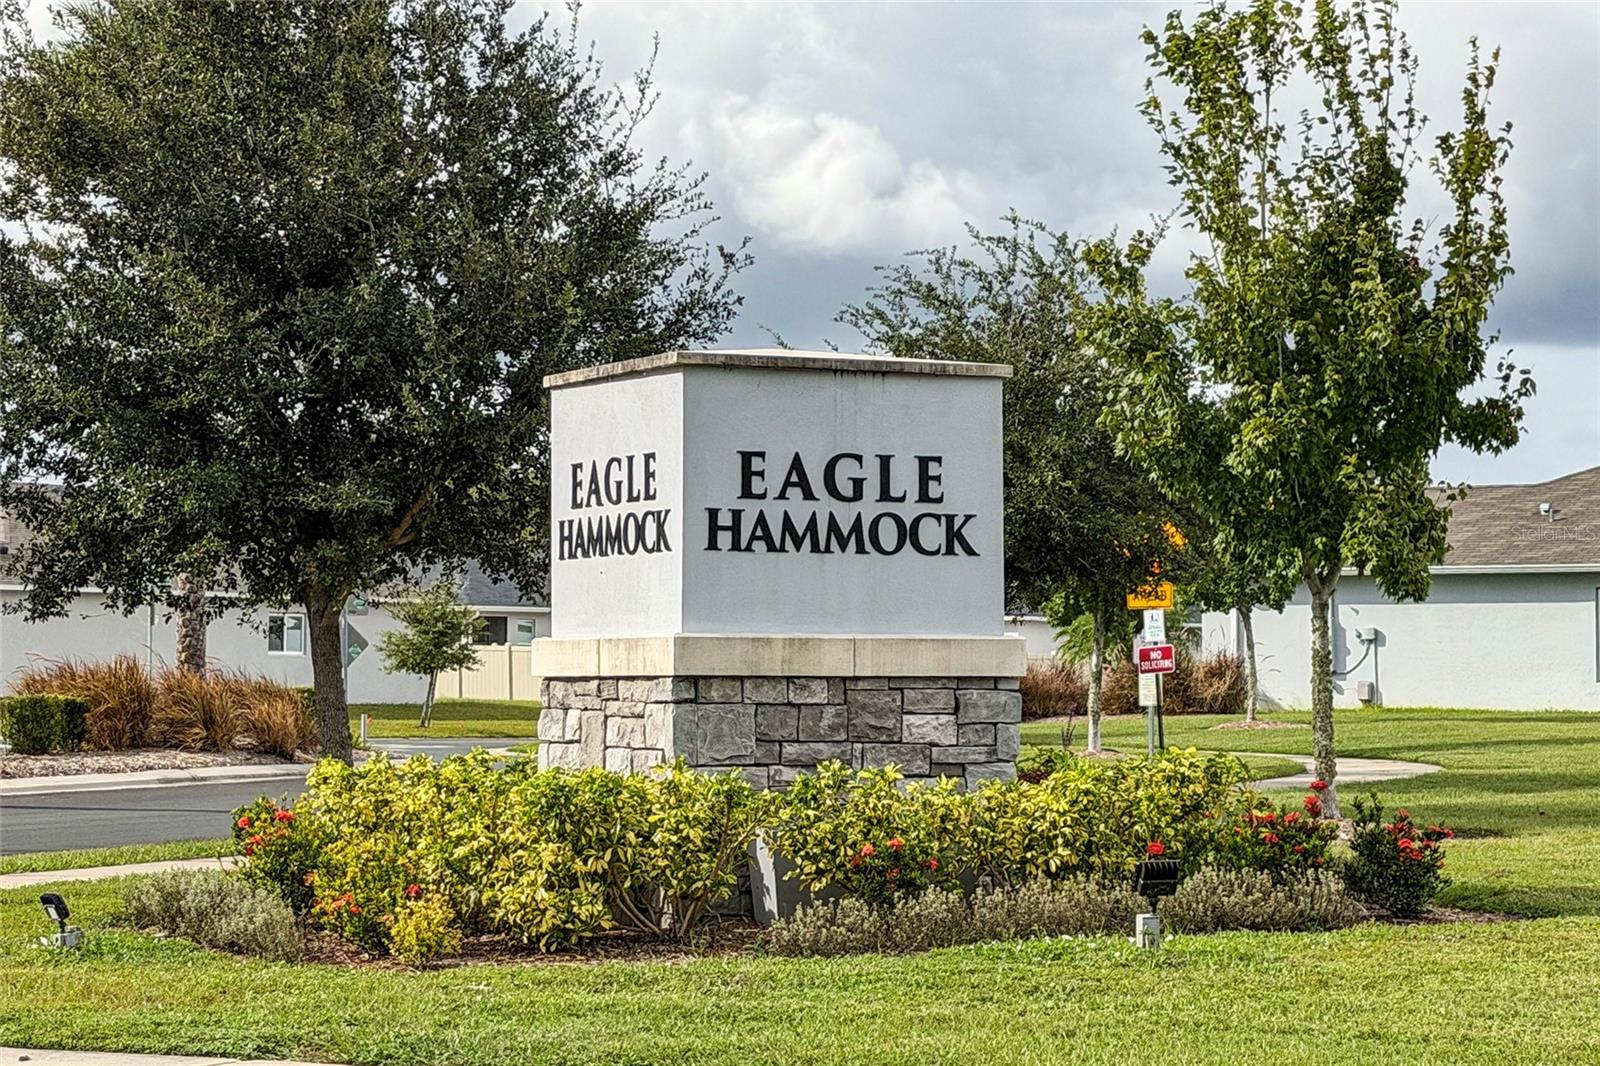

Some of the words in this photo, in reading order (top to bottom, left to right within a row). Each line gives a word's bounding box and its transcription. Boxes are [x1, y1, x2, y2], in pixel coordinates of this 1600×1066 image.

[571, 452, 657, 509] EAGLE
[736, 450, 944, 504] EAGLE
[558, 509, 672, 561] HAMMOCK
[704, 508, 980, 557] HAMMOCK
[1141, 659, 1173, 670] SOLICITING
[1150, 650, 1163, 660] NO
